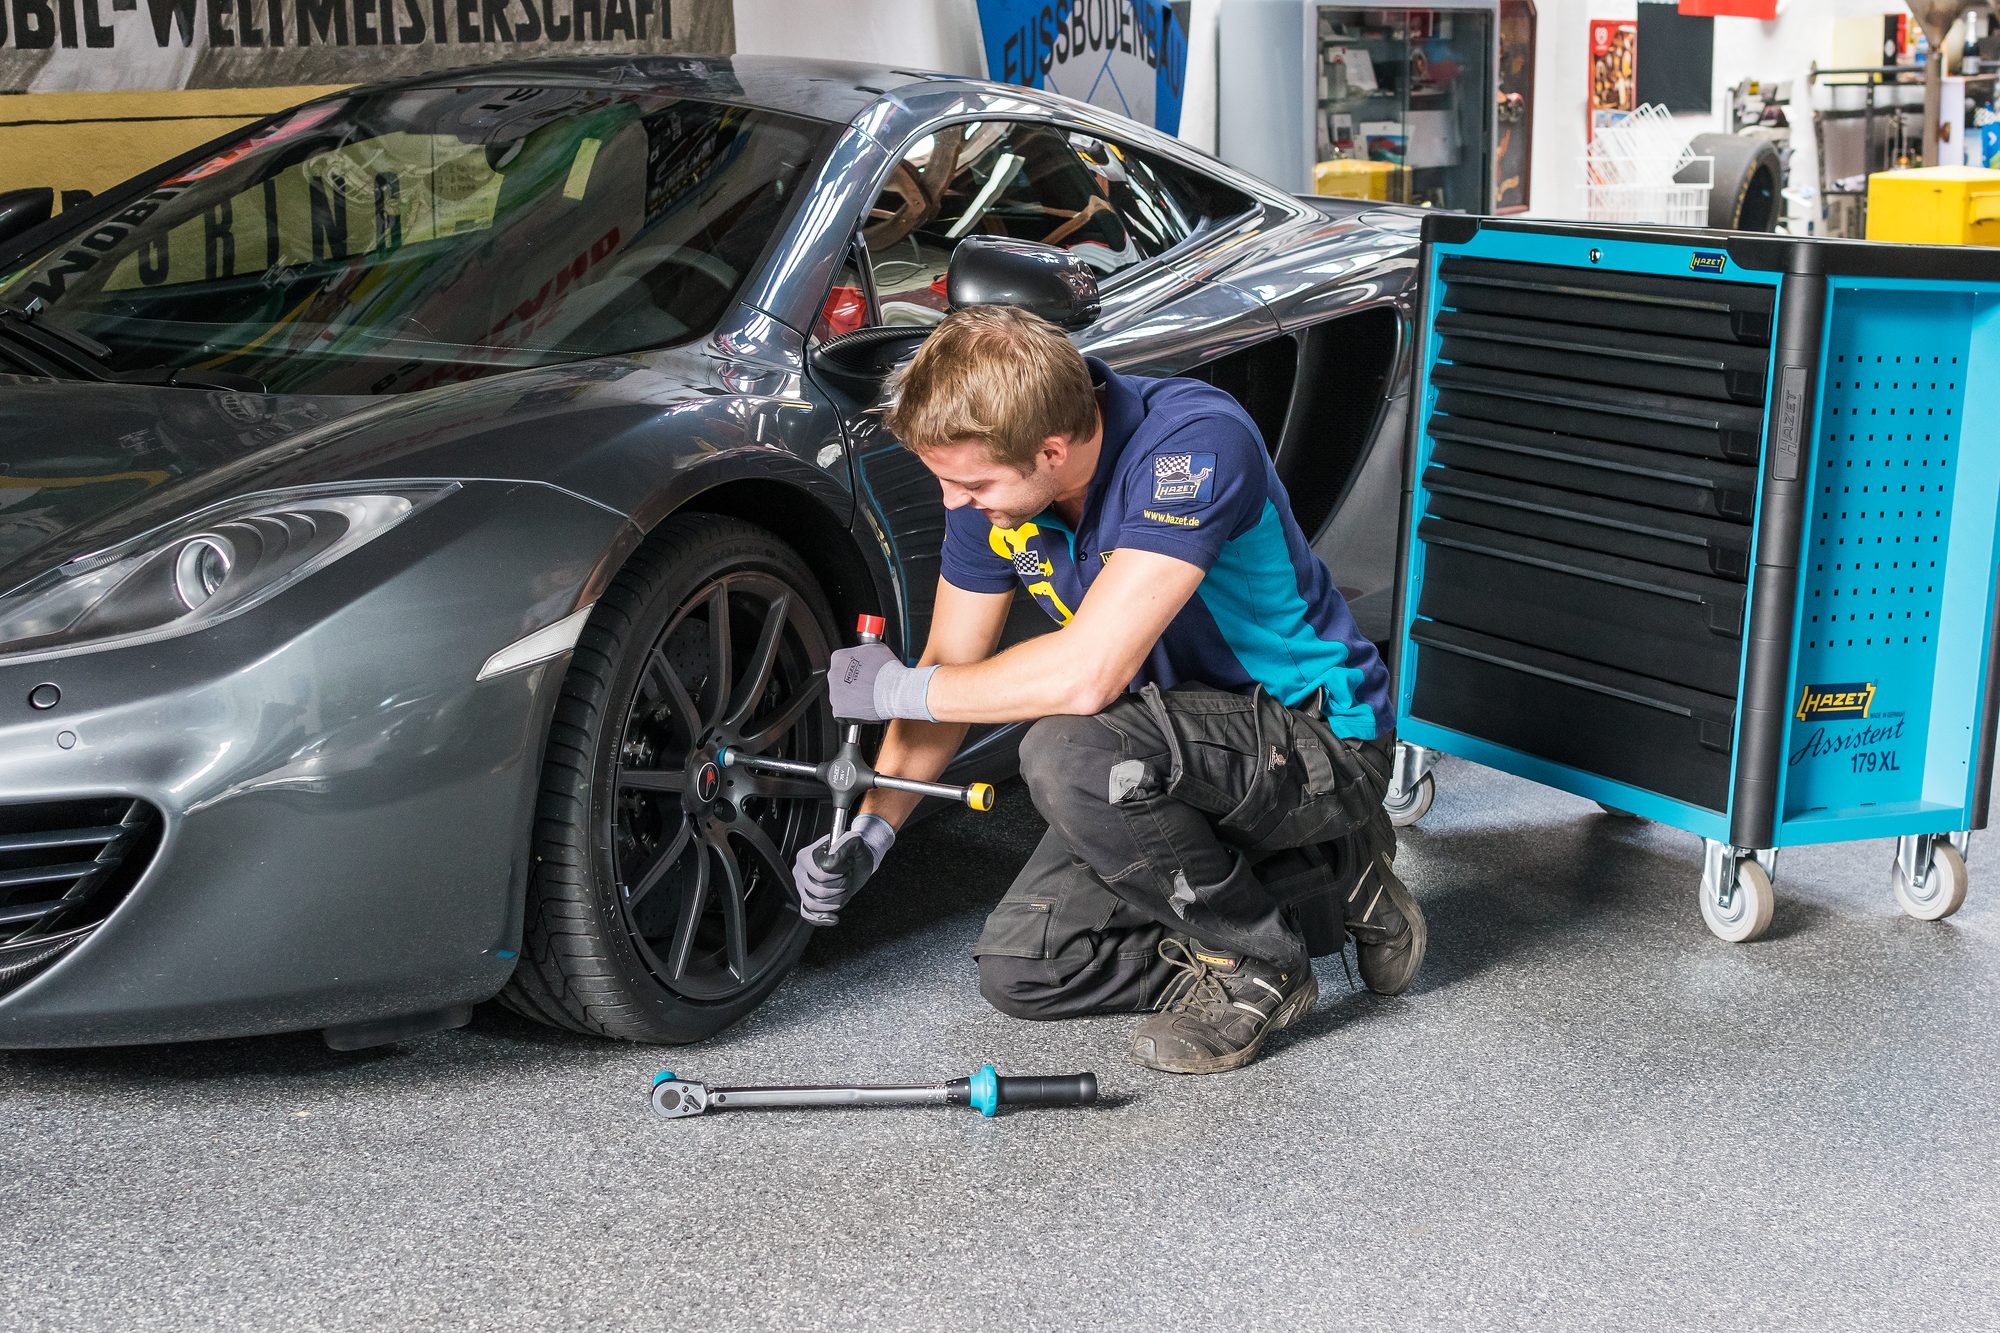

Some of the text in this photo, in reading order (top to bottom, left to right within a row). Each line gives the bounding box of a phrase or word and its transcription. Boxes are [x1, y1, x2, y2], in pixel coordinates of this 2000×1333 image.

[1003, 0, 1181, 98] FUSSBODENBAU
[1693, 256, 1722, 267] HAZET
[1779, 389, 1798, 458] HAZET
[1160, 485, 1196, 496] HAZET
[1143, 509, 1200, 527] www.hazet.de
[1804, 692, 1868, 713] HAZET
[1788, 717, 1905, 767] Assistent
[1851, 750, 1901, 773] 179 XL
